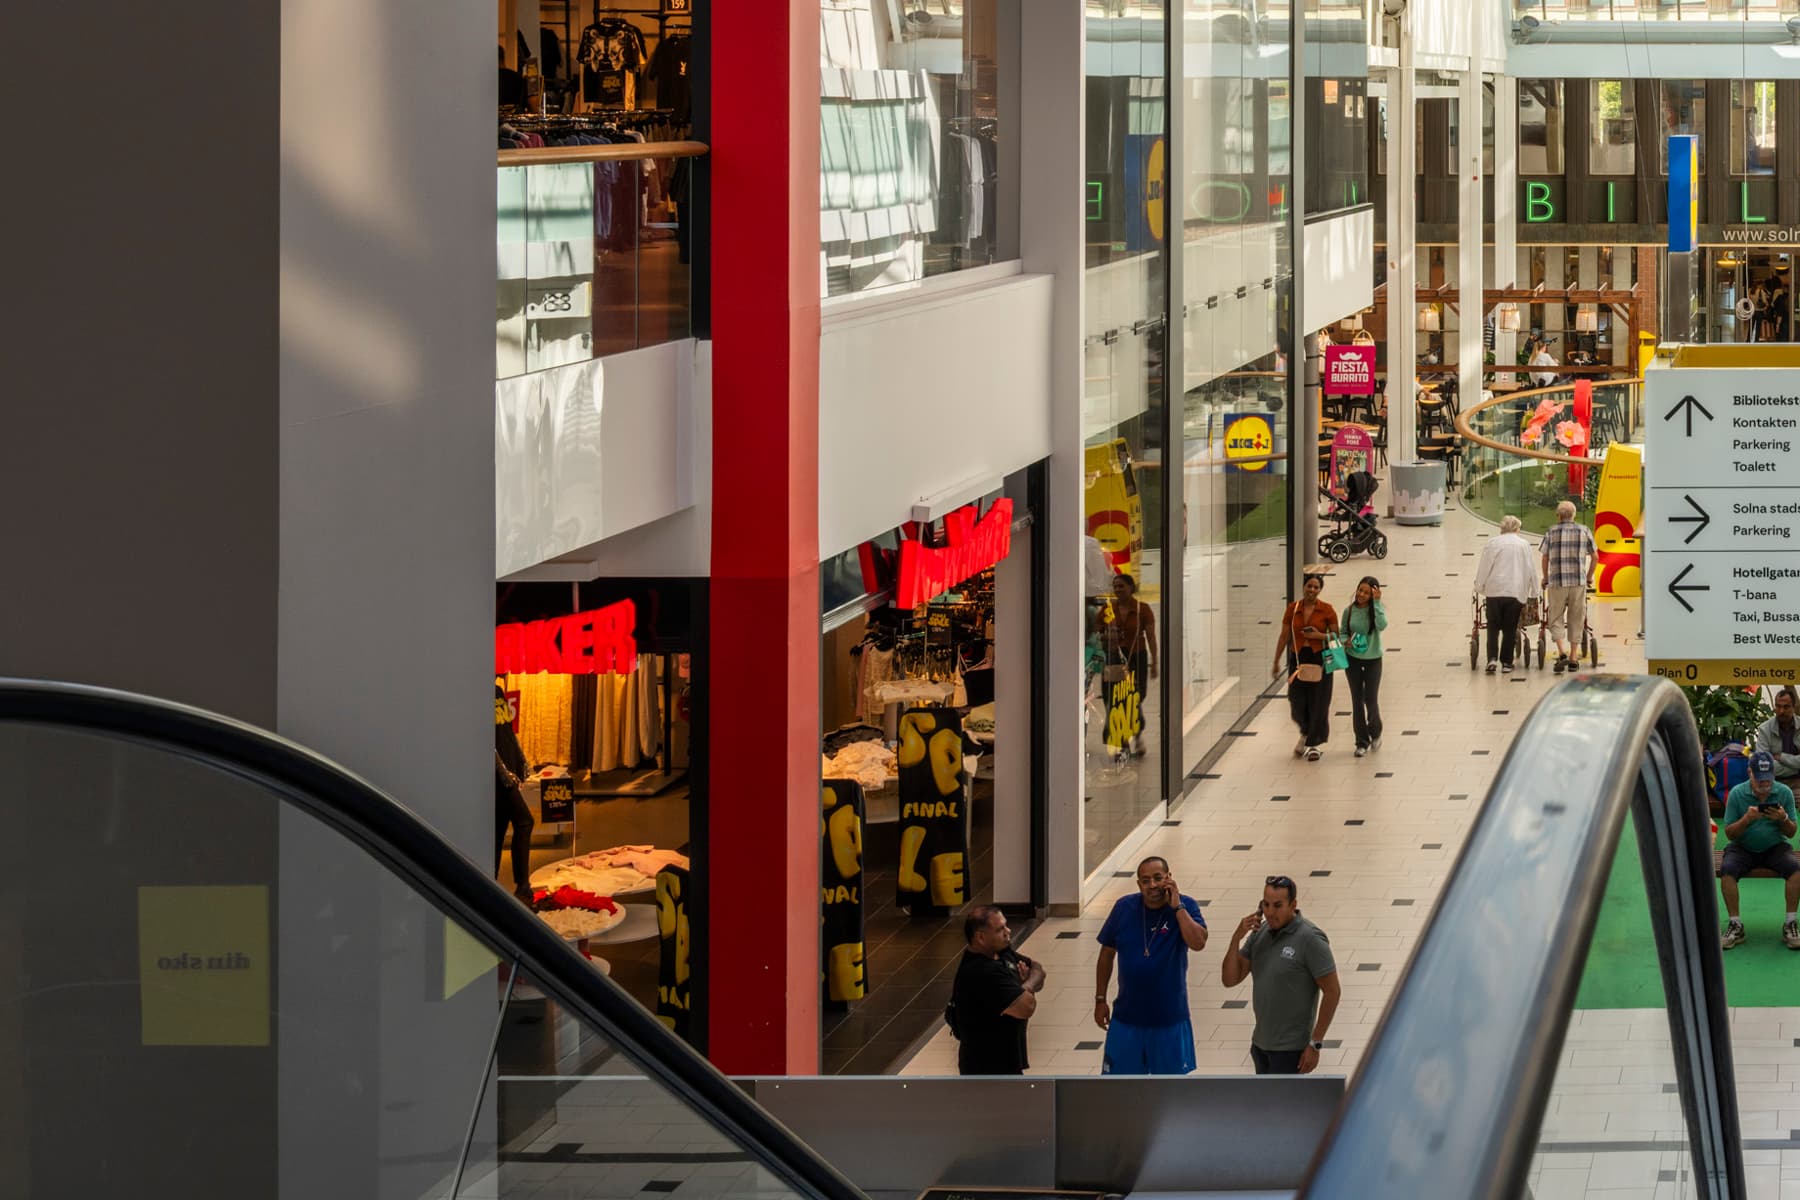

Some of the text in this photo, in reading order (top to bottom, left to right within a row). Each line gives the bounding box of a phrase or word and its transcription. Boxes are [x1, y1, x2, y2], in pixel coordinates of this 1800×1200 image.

[671, 0, 686, 10] 159
[1331, 361, 1369, 373] FIESTA
[1331, 373, 1369, 383] BURRITO
[1733, 416, 1797, 428] Kontakten
[1733, 438, 1791, 453] Parkering
[1733, 460, 1777, 472] Toalett
[1733, 502, 1767, 514] Solna
[1733, 524, 1791, 539] Parkering
[1733, 589, 1777, 600] T-bana
[1733, 611, 1760, 624] Taxi,
[1733, 633, 1761, 644] Best
[1656, 666, 1682, 679] Plan
[1733, 666, 1767, 678] Solna
[1770, 667, 1796, 681] torg
[902, 801, 959, 819] FINAL
[822, 885, 859, 905] NAL
